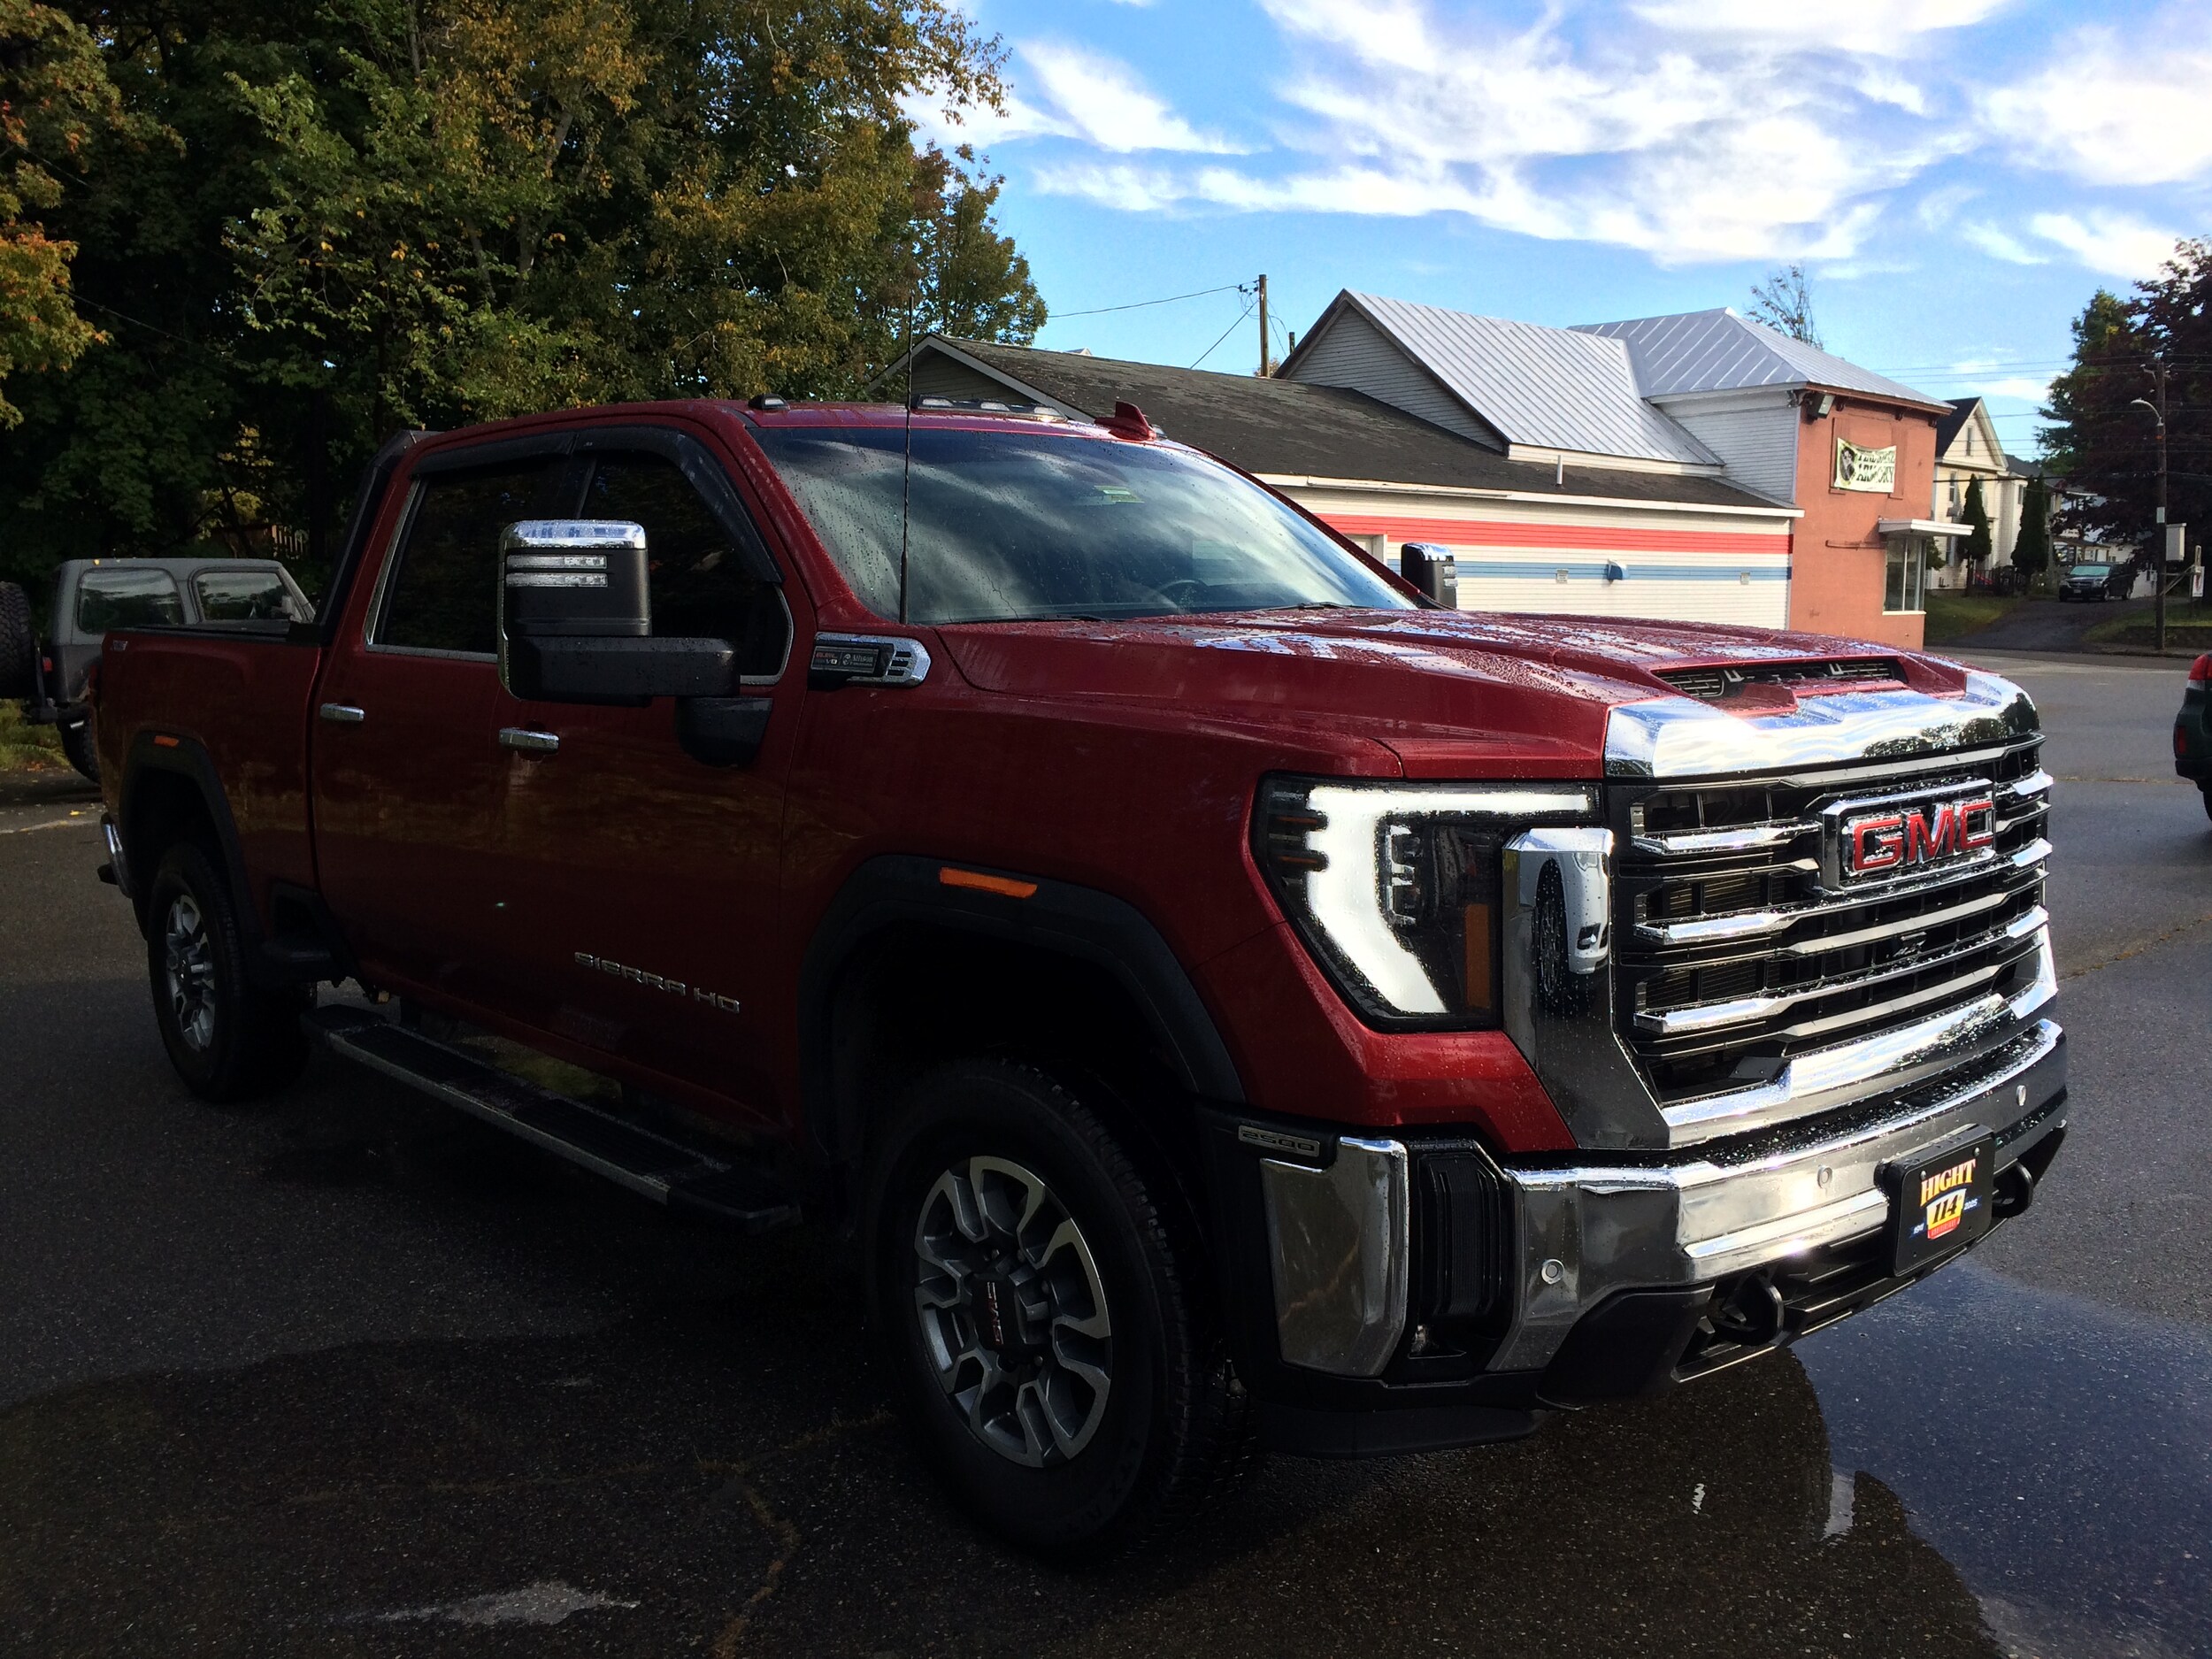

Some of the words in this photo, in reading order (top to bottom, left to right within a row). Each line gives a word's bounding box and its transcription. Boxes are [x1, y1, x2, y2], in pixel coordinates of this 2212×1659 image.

[1849, 798, 1994, 872] GMC
[575, 951, 686, 996] SIERRA
[693, 987, 740, 1014] HD
[1241, 1130, 1315, 1152] 2500
[1920, 1158, 1977, 1208] HIGHT
[1932, 1194, 1959, 1225] 114
